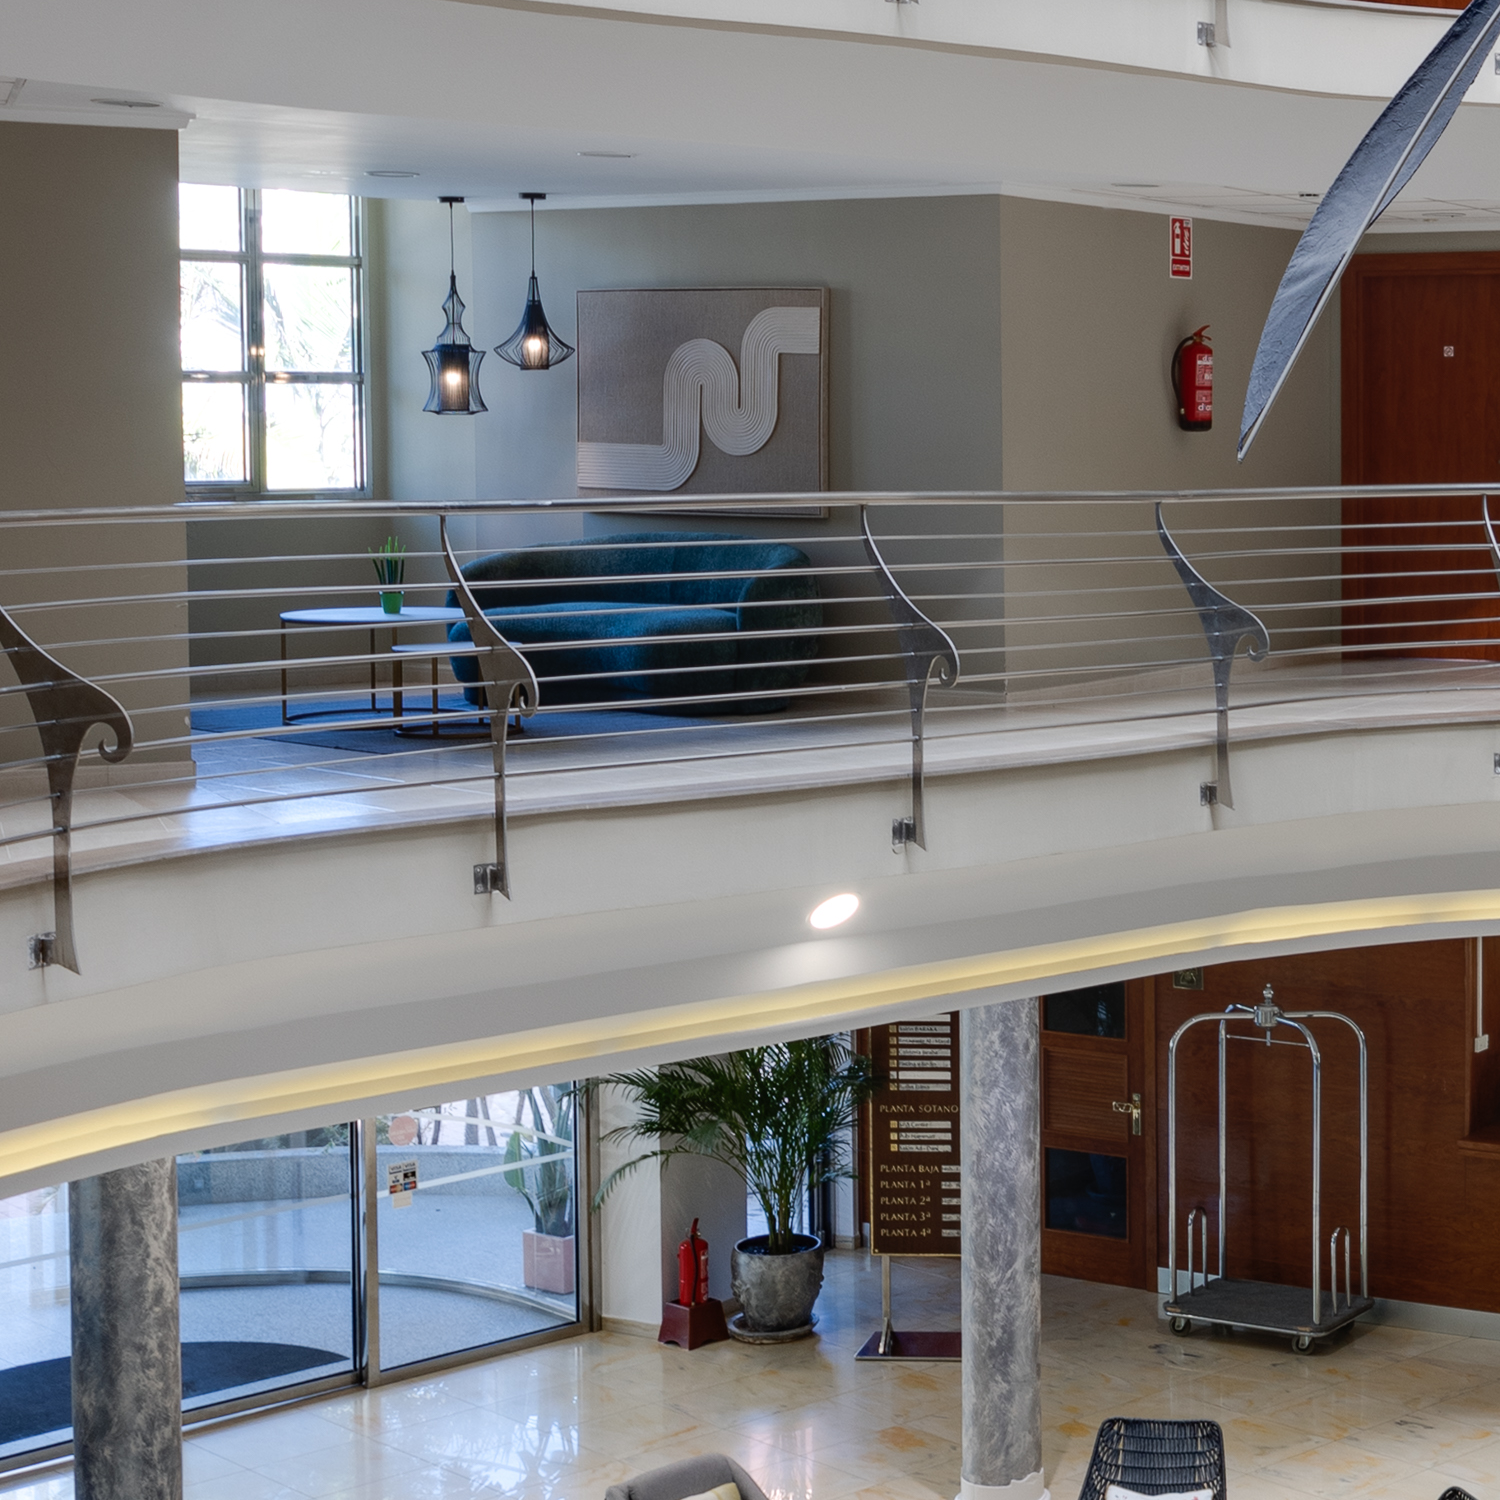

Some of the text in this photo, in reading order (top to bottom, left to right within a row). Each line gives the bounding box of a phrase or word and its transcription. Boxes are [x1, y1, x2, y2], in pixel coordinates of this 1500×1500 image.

[880, 1104, 959, 1113] PLANTA SOTANO
[880, 1164, 916, 1173] PLANTA
[918, 1164, 940, 1174] BAJA
[880, 1181, 917, 1189] PLANTA
[880, 1197, 917, 1205] PLANTA
[880, 1213, 917, 1221] PLANTA
[880, 1229, 917, 1237] PLANTA
